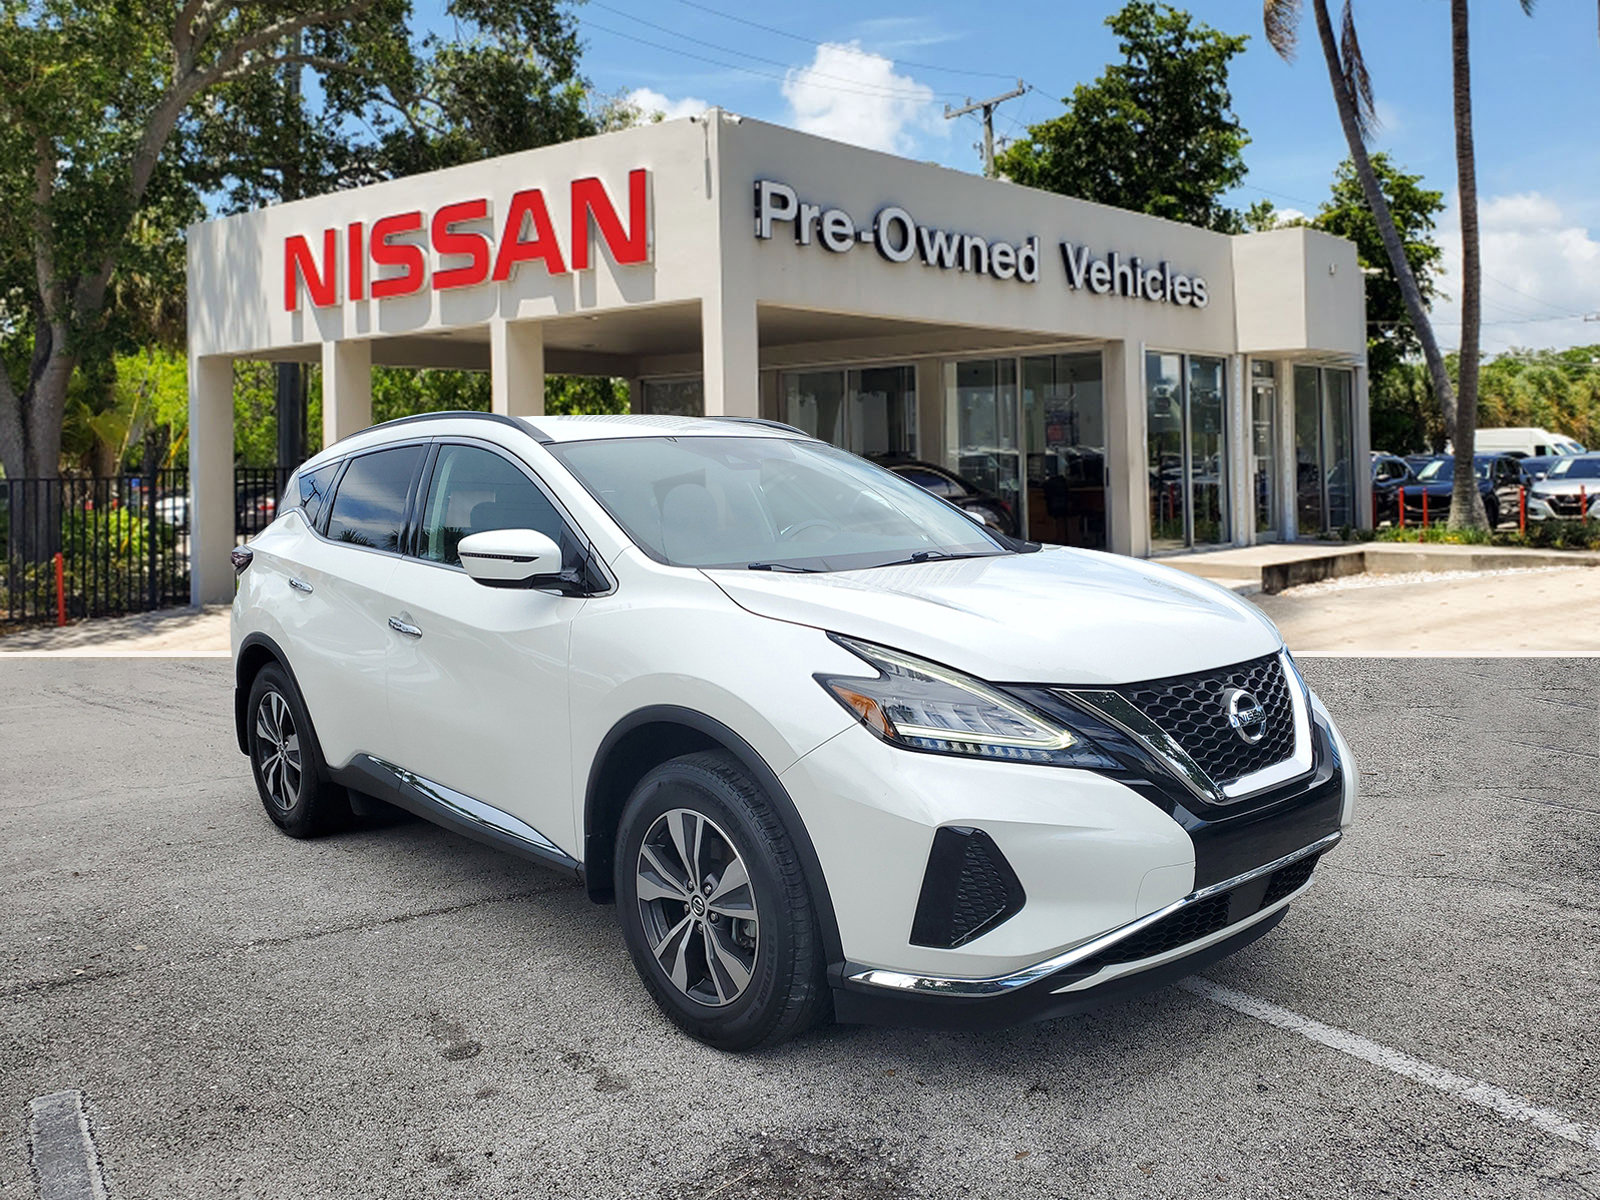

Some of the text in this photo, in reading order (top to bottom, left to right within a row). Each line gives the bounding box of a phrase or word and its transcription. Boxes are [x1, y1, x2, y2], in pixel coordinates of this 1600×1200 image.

[285, 169, 649, 311] NISSAN
[755, 180, 1209, 308] Pre-Owned Vehicles
